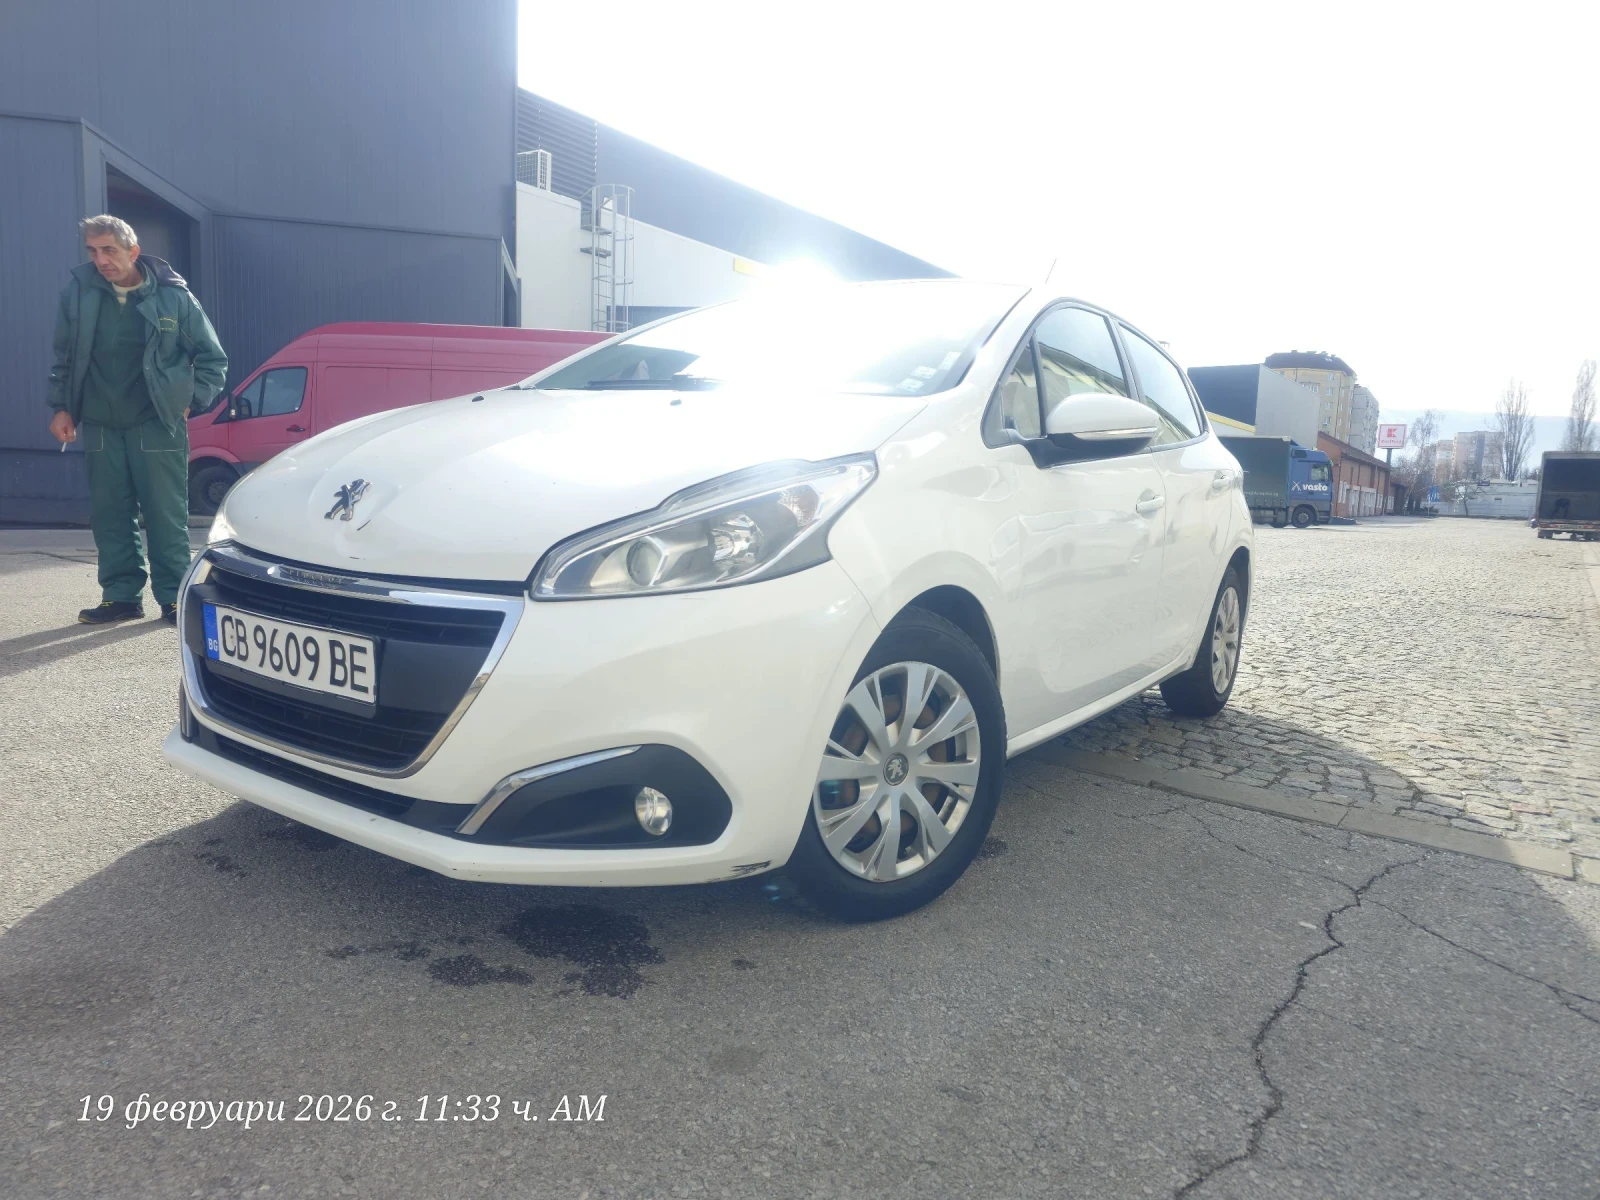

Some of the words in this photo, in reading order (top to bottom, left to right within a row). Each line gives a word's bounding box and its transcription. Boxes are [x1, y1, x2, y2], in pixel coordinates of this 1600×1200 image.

[1303, 482, 1328, 491] vasto
[207, 638, 219, 651] BG
[221, 614, 249, 662] CB
[253, 624, 320, 681] 9609
[329, 639, 369, 694] BE
